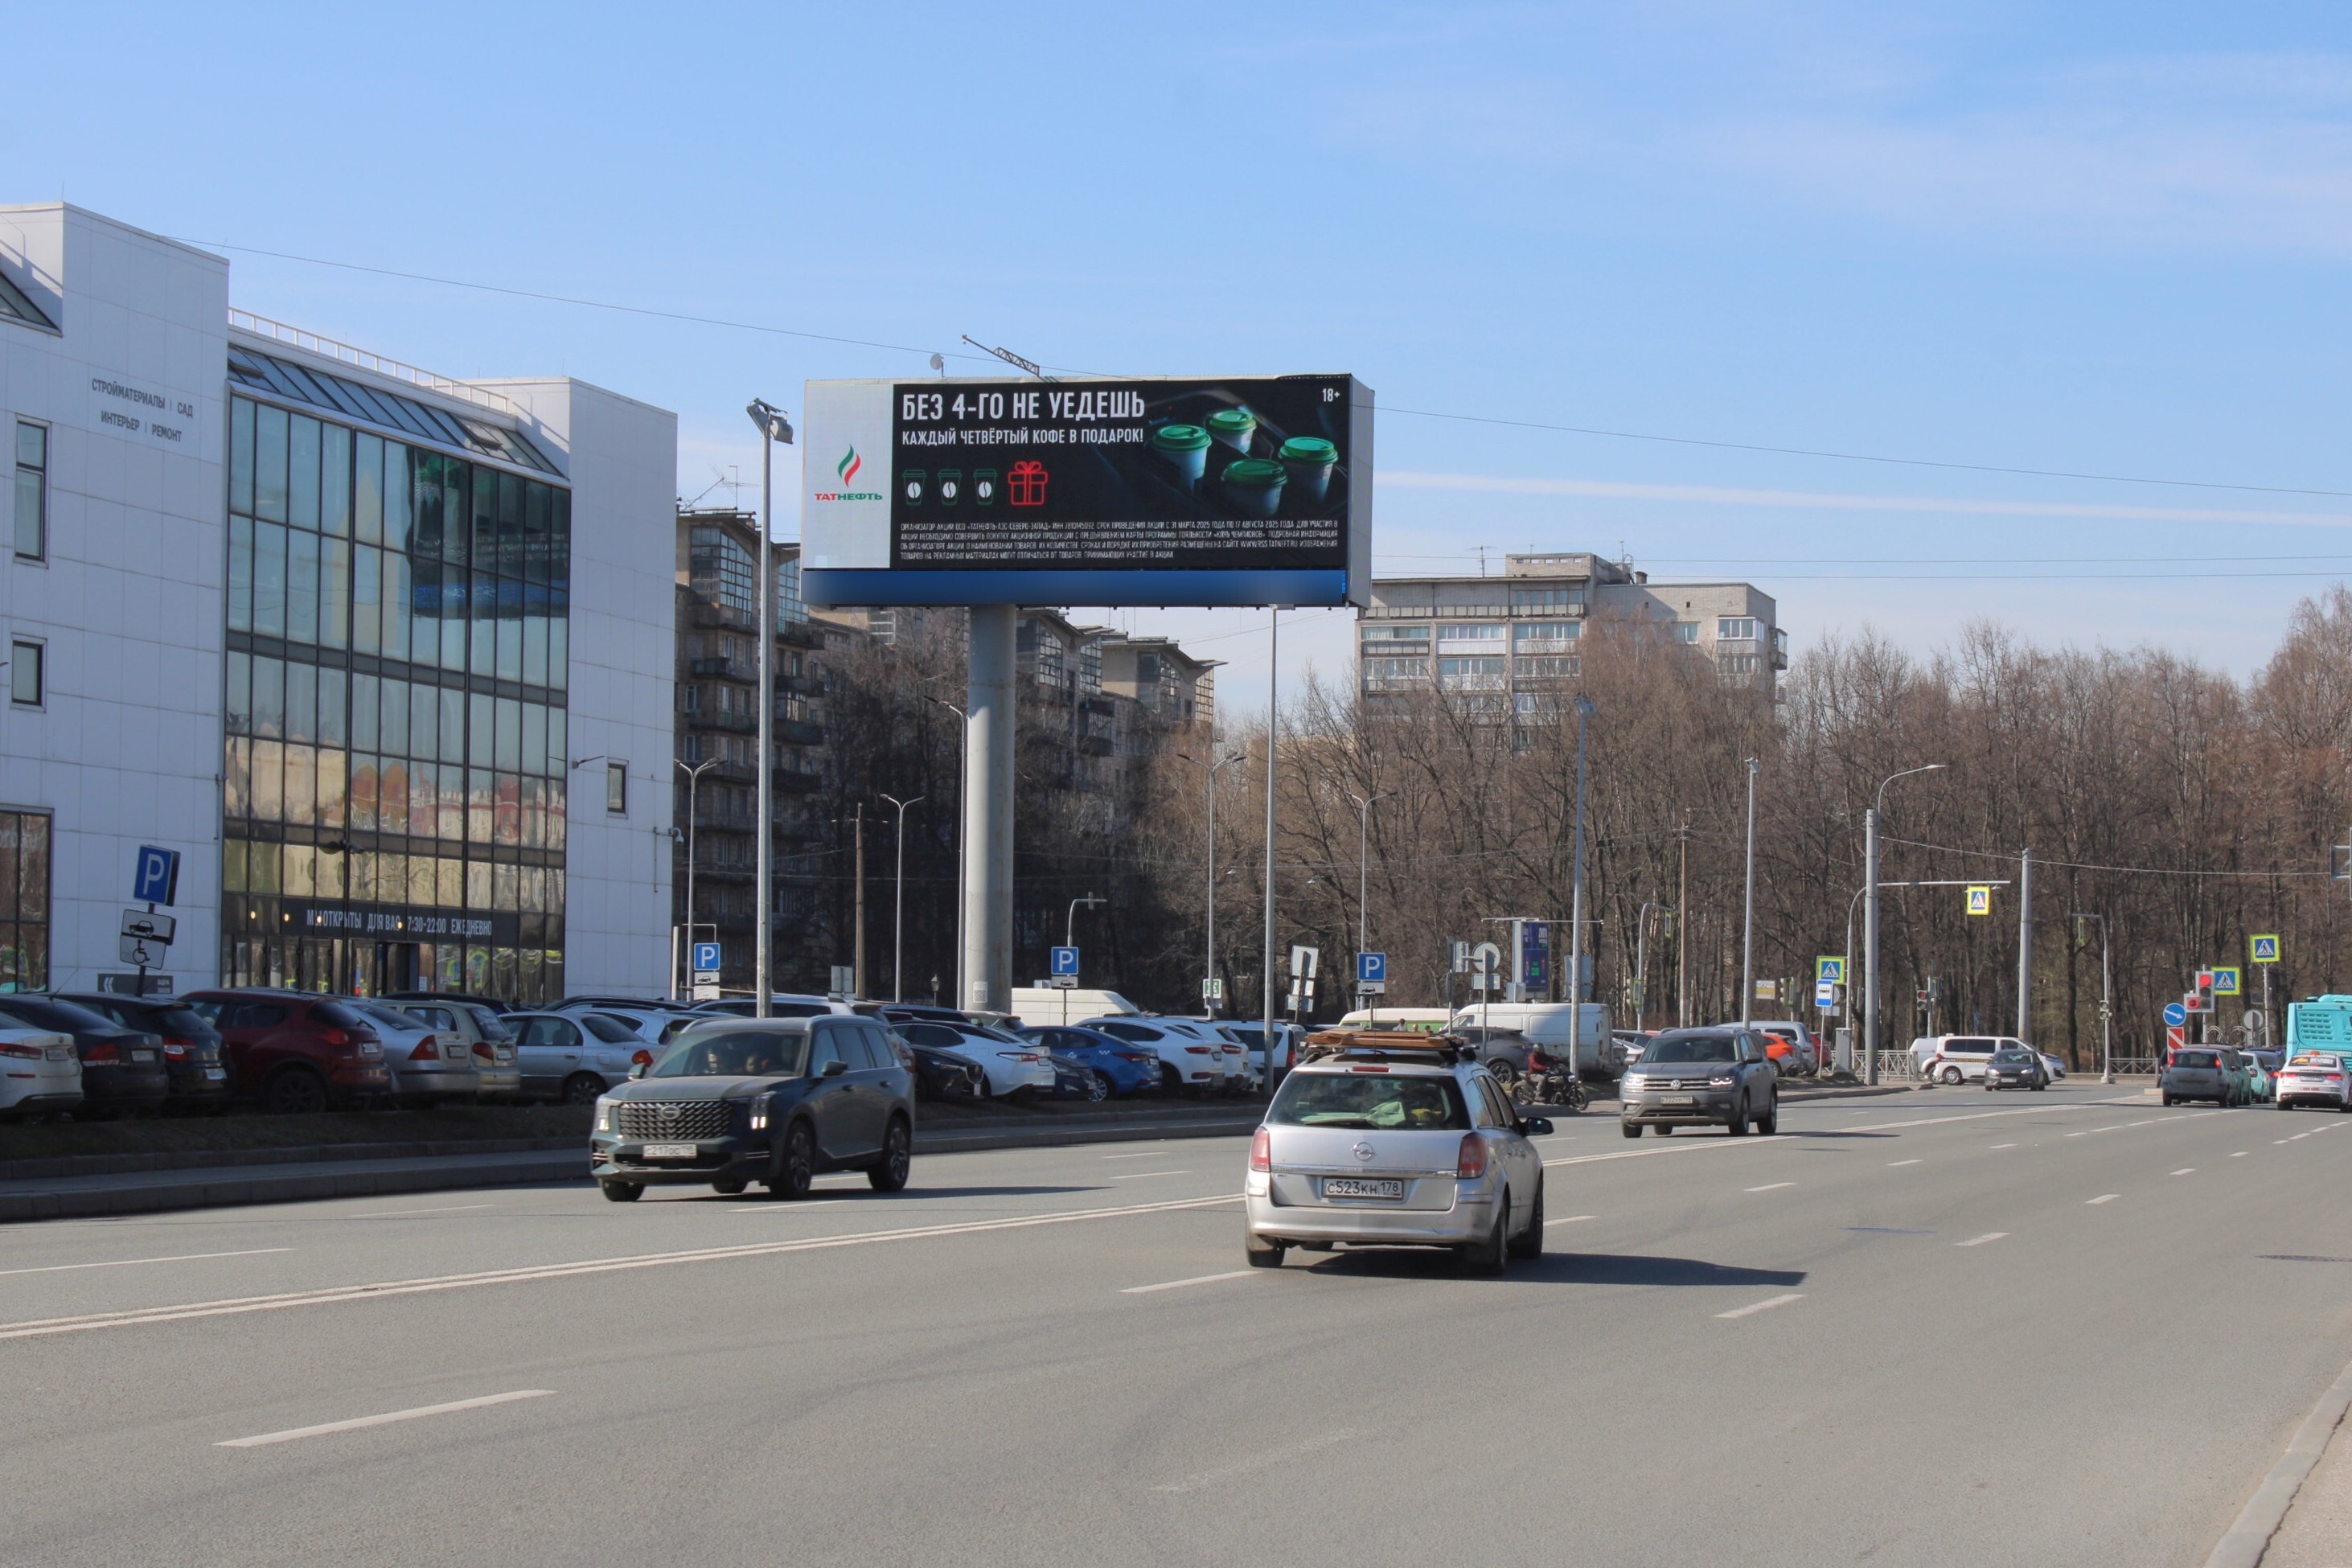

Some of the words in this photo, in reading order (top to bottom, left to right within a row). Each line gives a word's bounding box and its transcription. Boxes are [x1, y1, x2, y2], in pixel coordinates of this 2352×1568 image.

[92, 378, 166, 409] СТРОЙМАТЕРИАЛЫ
[177, 402, 193, 419] САД
[1322, 388, 1340, 402] 18+
[902, 393, 943, 421] БЕЗ
[952, 392, 1004, 420] 4-ГО
[1013, 392, 1040, 419] НЕ
[1049, 391, 1145, 421] УЕДЕШЬ
[101, 409, 140, 431] ИНТЕРЬЕР
[152, 423, 182, 442] РЕМОНТ
[902, 428, 955, 446] КАЖДЫЙ
[961, 427, 1028, 445] ЧЕТВЁРТЫЙ
[1033, 429, 1065, 444] КОФЕ
[1070, 429, 1077, 443] В
[1082, 428, 1143, 445] ПОДАРОК!
[815, 493, 883, 501] ТАТНЕФТЬ
[901, 523, 935, 531] ОРГАНИЗАТОР
[937, 523, 954, 531] АКЦИИ
[955, 523, 965, 531] ООО
[1053, 522, 1063, 530] ИНН
[1111, 521, 1145, 529] ПРОВЕДЕНИЯ
[1147, 521, 1164, 529] АКЦИИ
[1178, 521, 1195, 529] МАРТА
[1242, 520, 1263, 528] АВГУСТА
[1266, 520, 1279, 528] 2025
[920, 532, 953, 540] НЕОБХОДИМО
[1126, 531, 1143, 539] КАРТЫ
[142, 853, 165, 895] P
[322, 910, 362, 929] ОТКРЫТЫ
[367, 913, 384, 932] ДЛЯ
[385, 914, 401, 931] ВАС
[408, 916, 446, 934] 7:30-22:00
[451, 918, 492, 938] ЕЖЕДНЕВНО
[701, 946, 715, 967] P
[1058, 950, 1073, 971] P
[1365, 956, 1381, 977] P
[1380, 1181, 1399, 1192] 178
